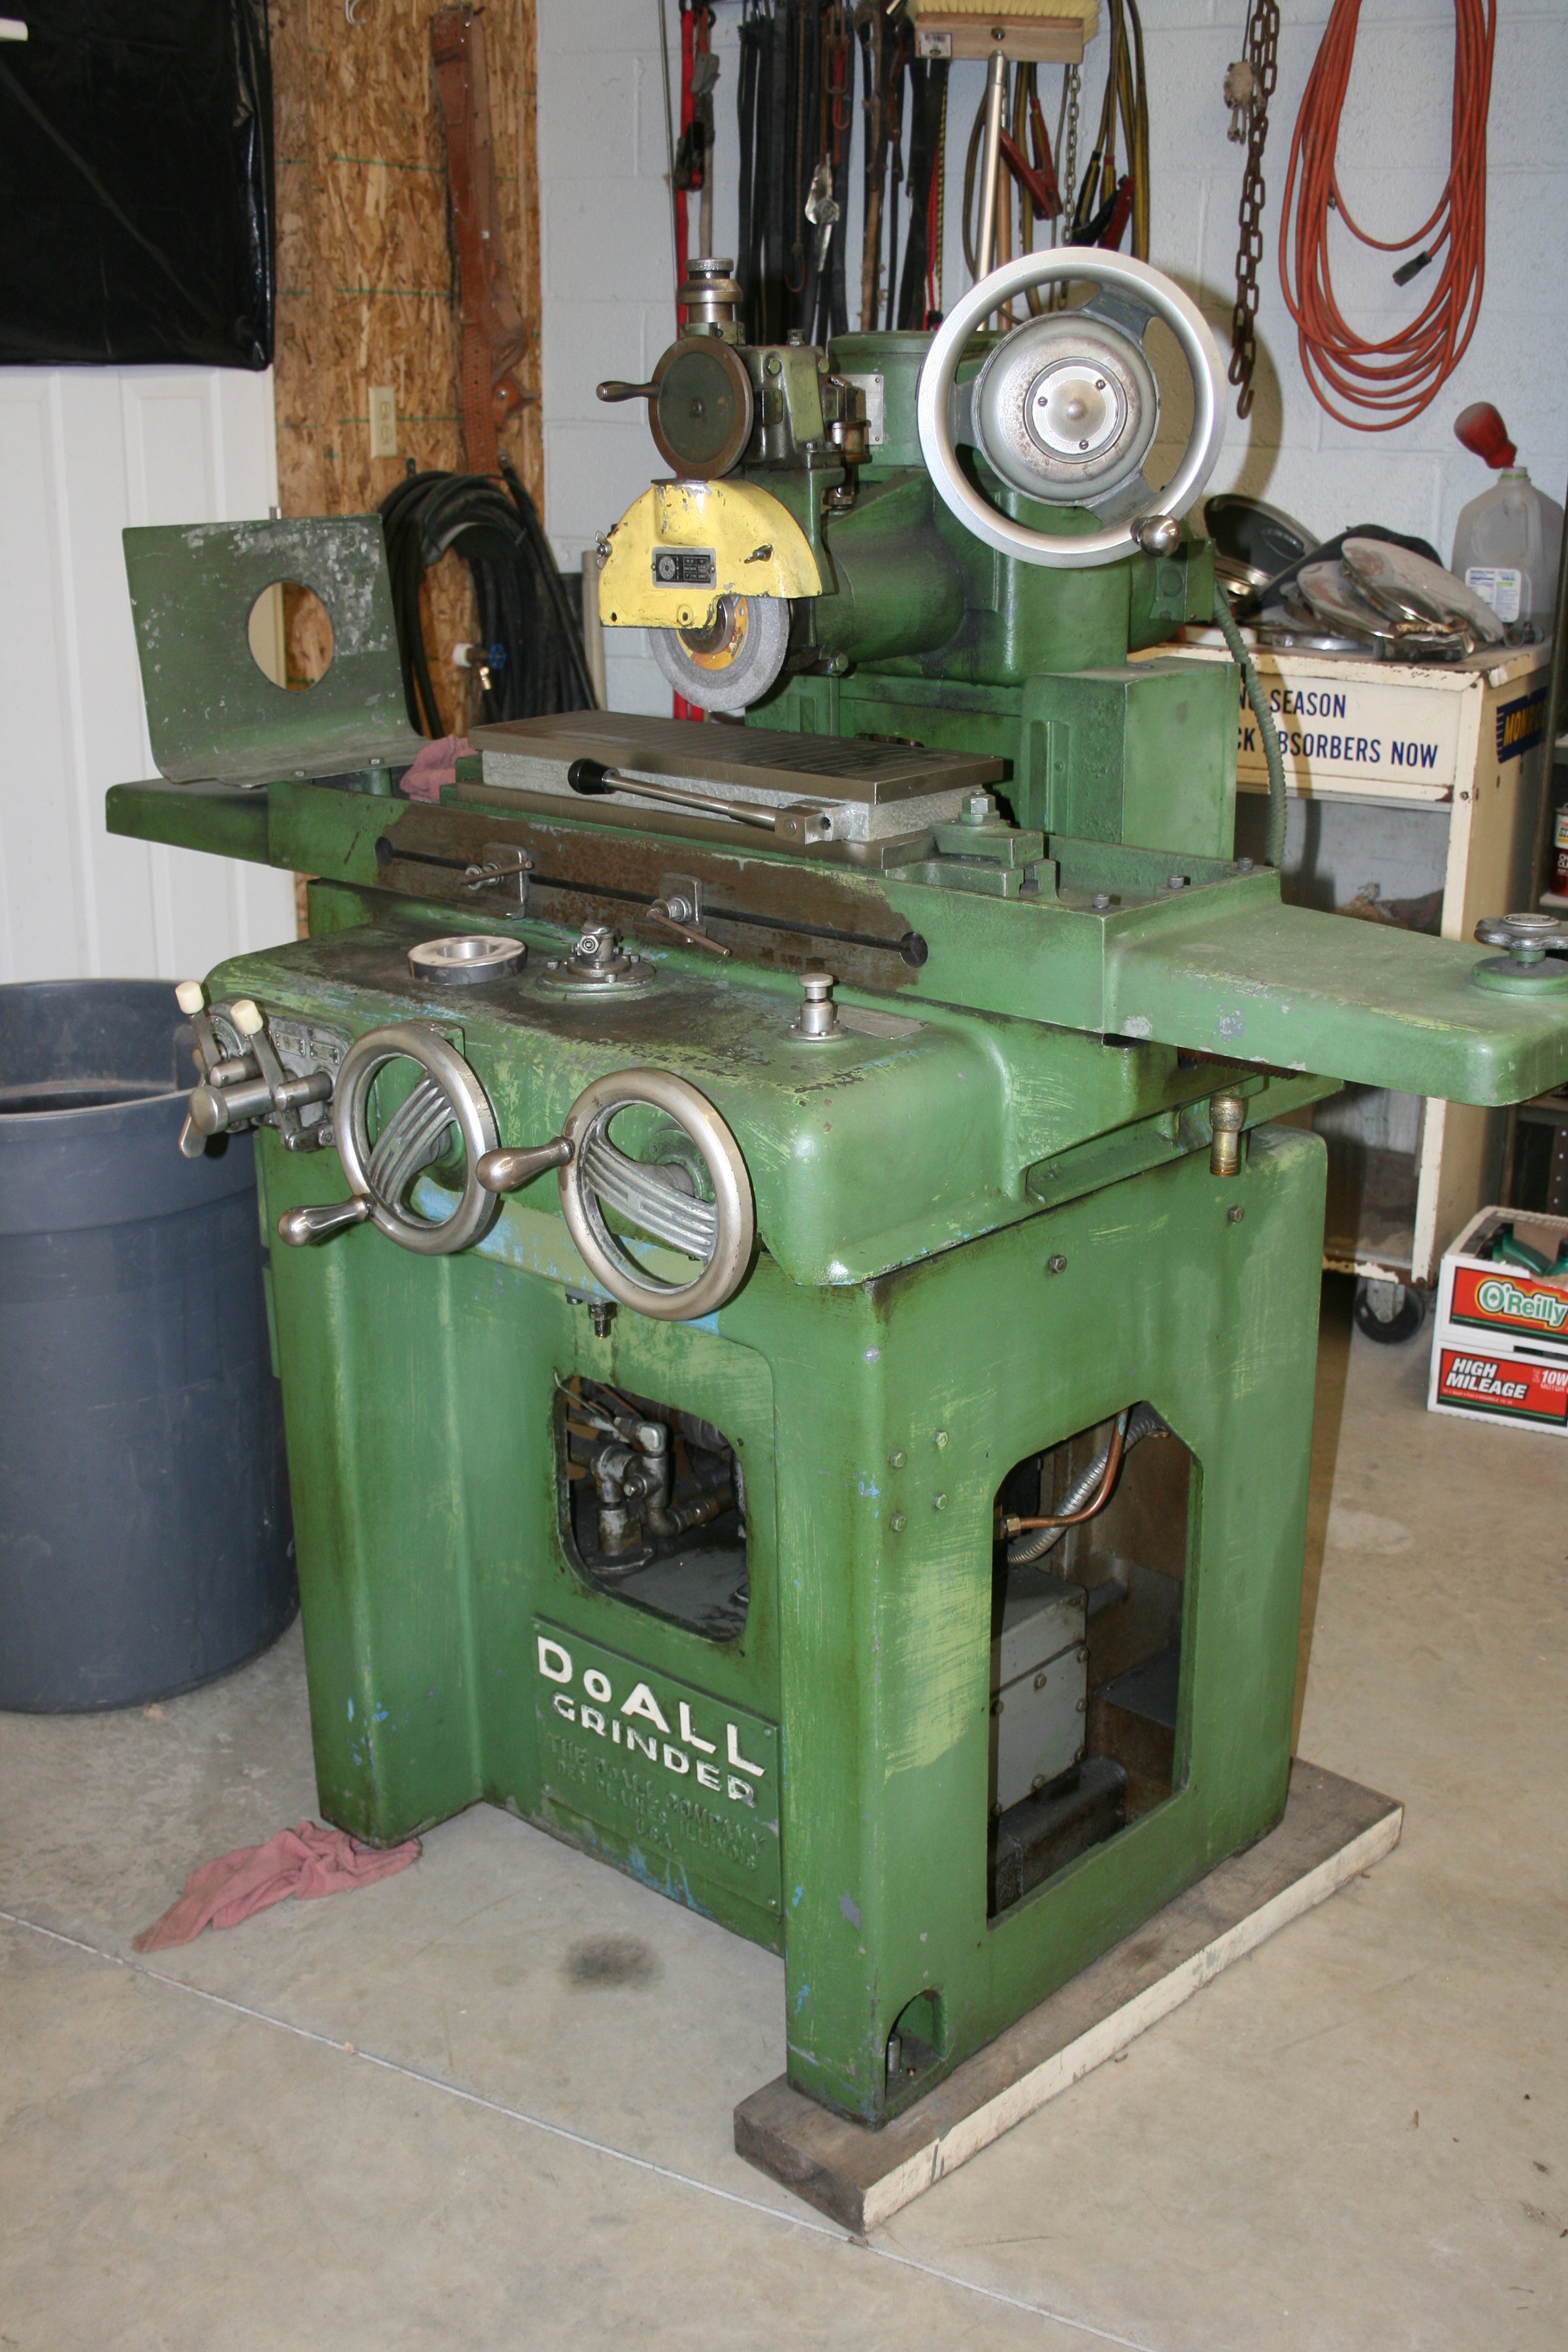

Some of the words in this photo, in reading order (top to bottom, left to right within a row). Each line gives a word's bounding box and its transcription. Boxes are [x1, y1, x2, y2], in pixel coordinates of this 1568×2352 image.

[1269, 689, 1346, 718] SEASON
[1264, 731, 1381, 763] BSORBERS
[1391, 740, 1439, 768] NOW
[1480, 1281, 1567, 1326] O'Reilly
[1452, 1357, 1498, 1379] HIGH
[1445, 1373, 1528, 1399] MILEAGE
[553, 1692, 756, 1808] GRINDER
